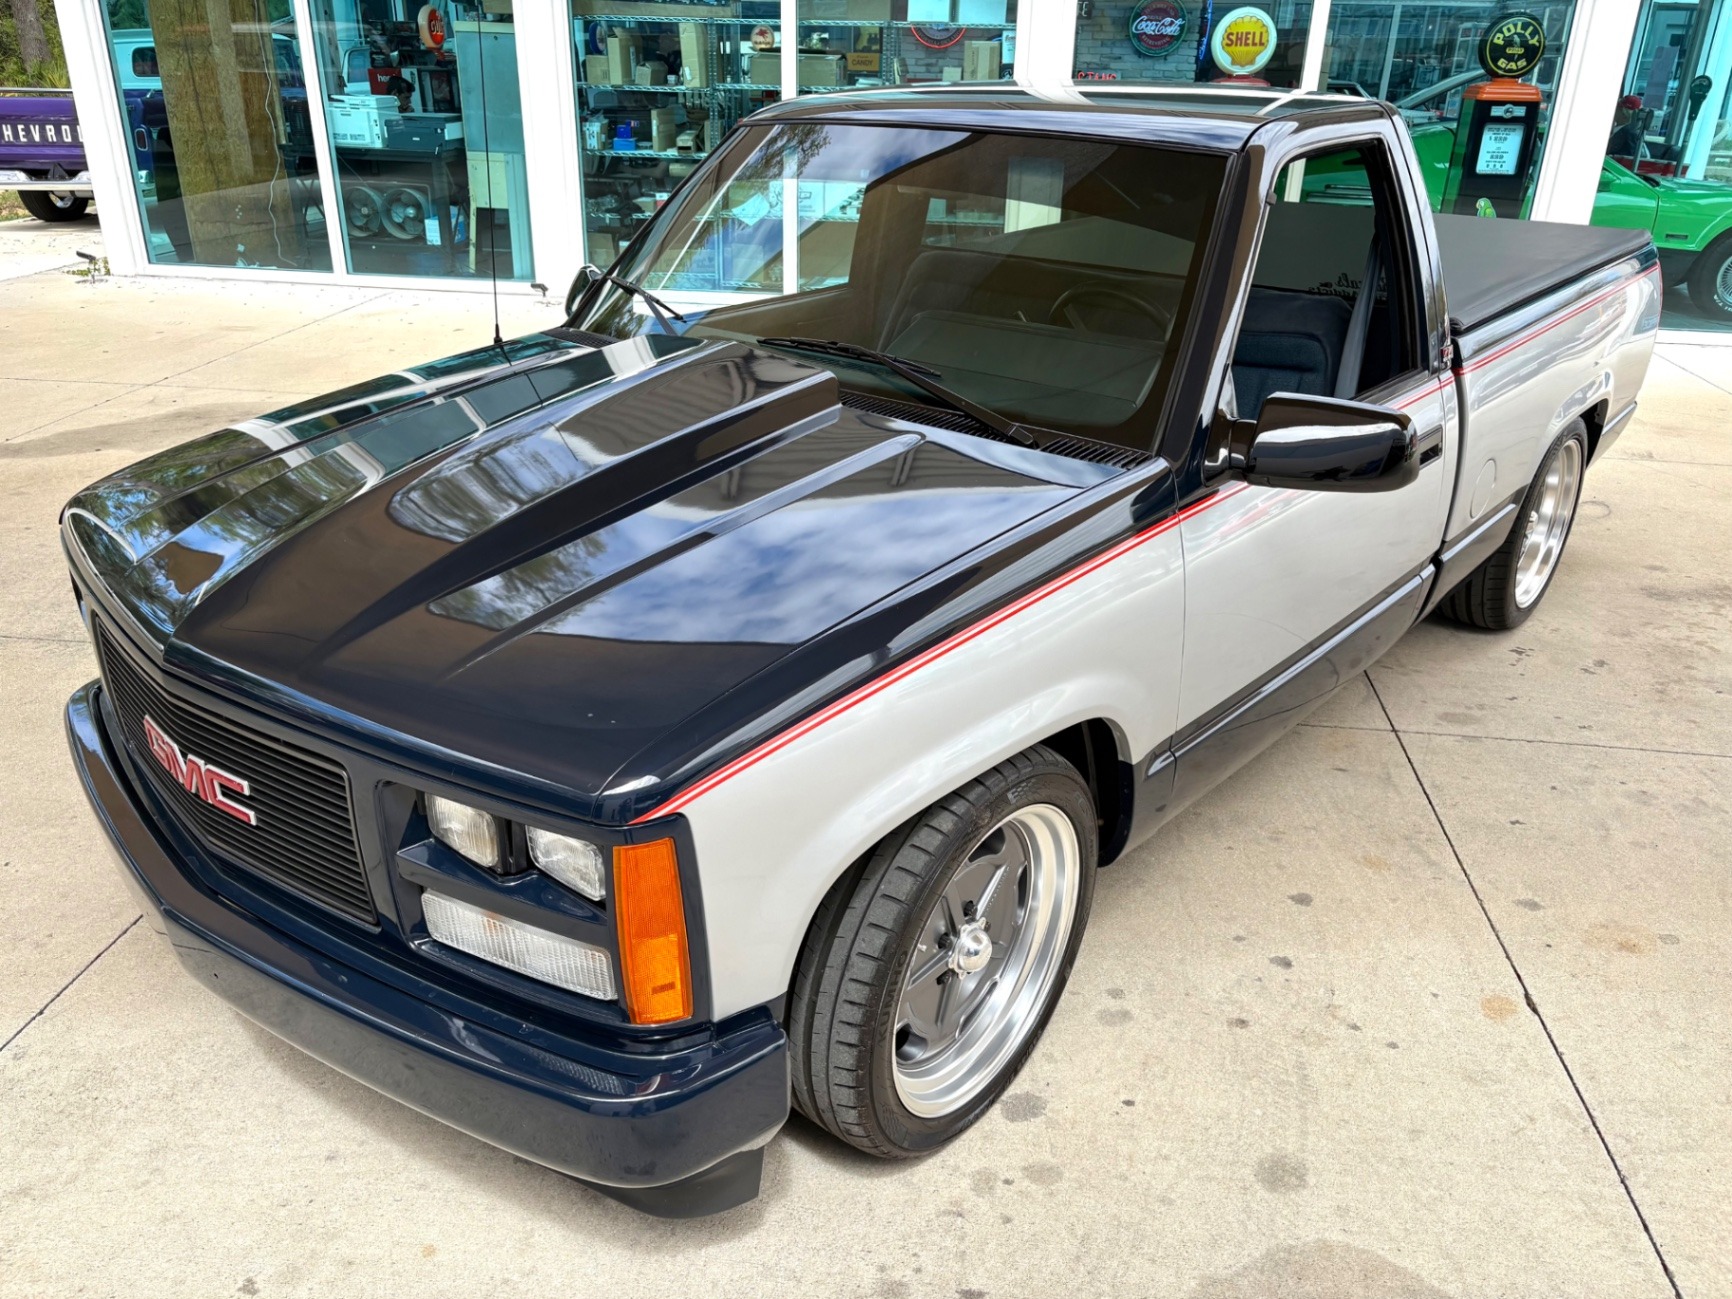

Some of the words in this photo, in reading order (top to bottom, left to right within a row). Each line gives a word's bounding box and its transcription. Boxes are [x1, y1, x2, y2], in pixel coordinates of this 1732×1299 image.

[1225, 31, 1265, 47] SHELL
[1493, 21, 1540, 47] POLLY
[852, 58, 873, 67] CANDY
[1497, 58, 1527, 70] GAS
[143, 714, 257, 826] GMC
[879, 950, 908, 1043] KUMHO
